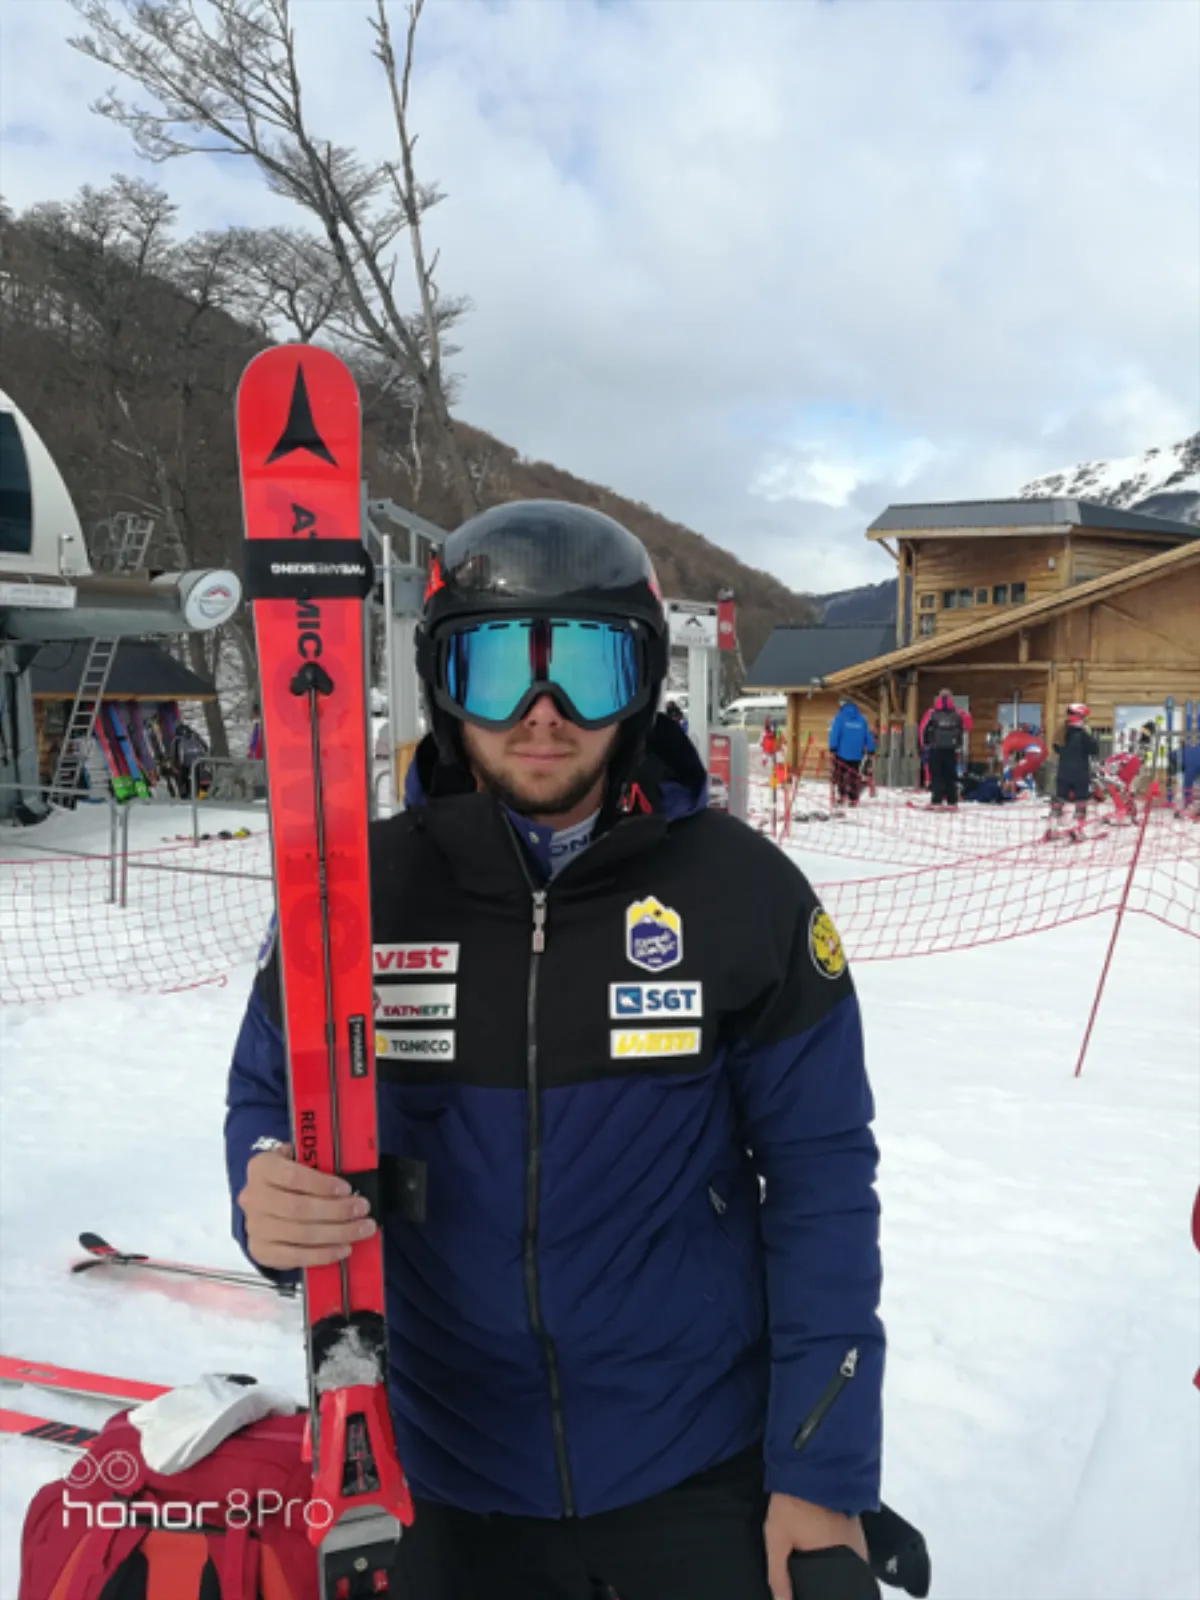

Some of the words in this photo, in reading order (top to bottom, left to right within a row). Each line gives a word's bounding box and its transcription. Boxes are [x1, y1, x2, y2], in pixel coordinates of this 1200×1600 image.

[291, 503, 323, 659] AMIC
[382, 1005, 450, 1017] TATNEFT
[646, 989, 697, 1011] SGT
